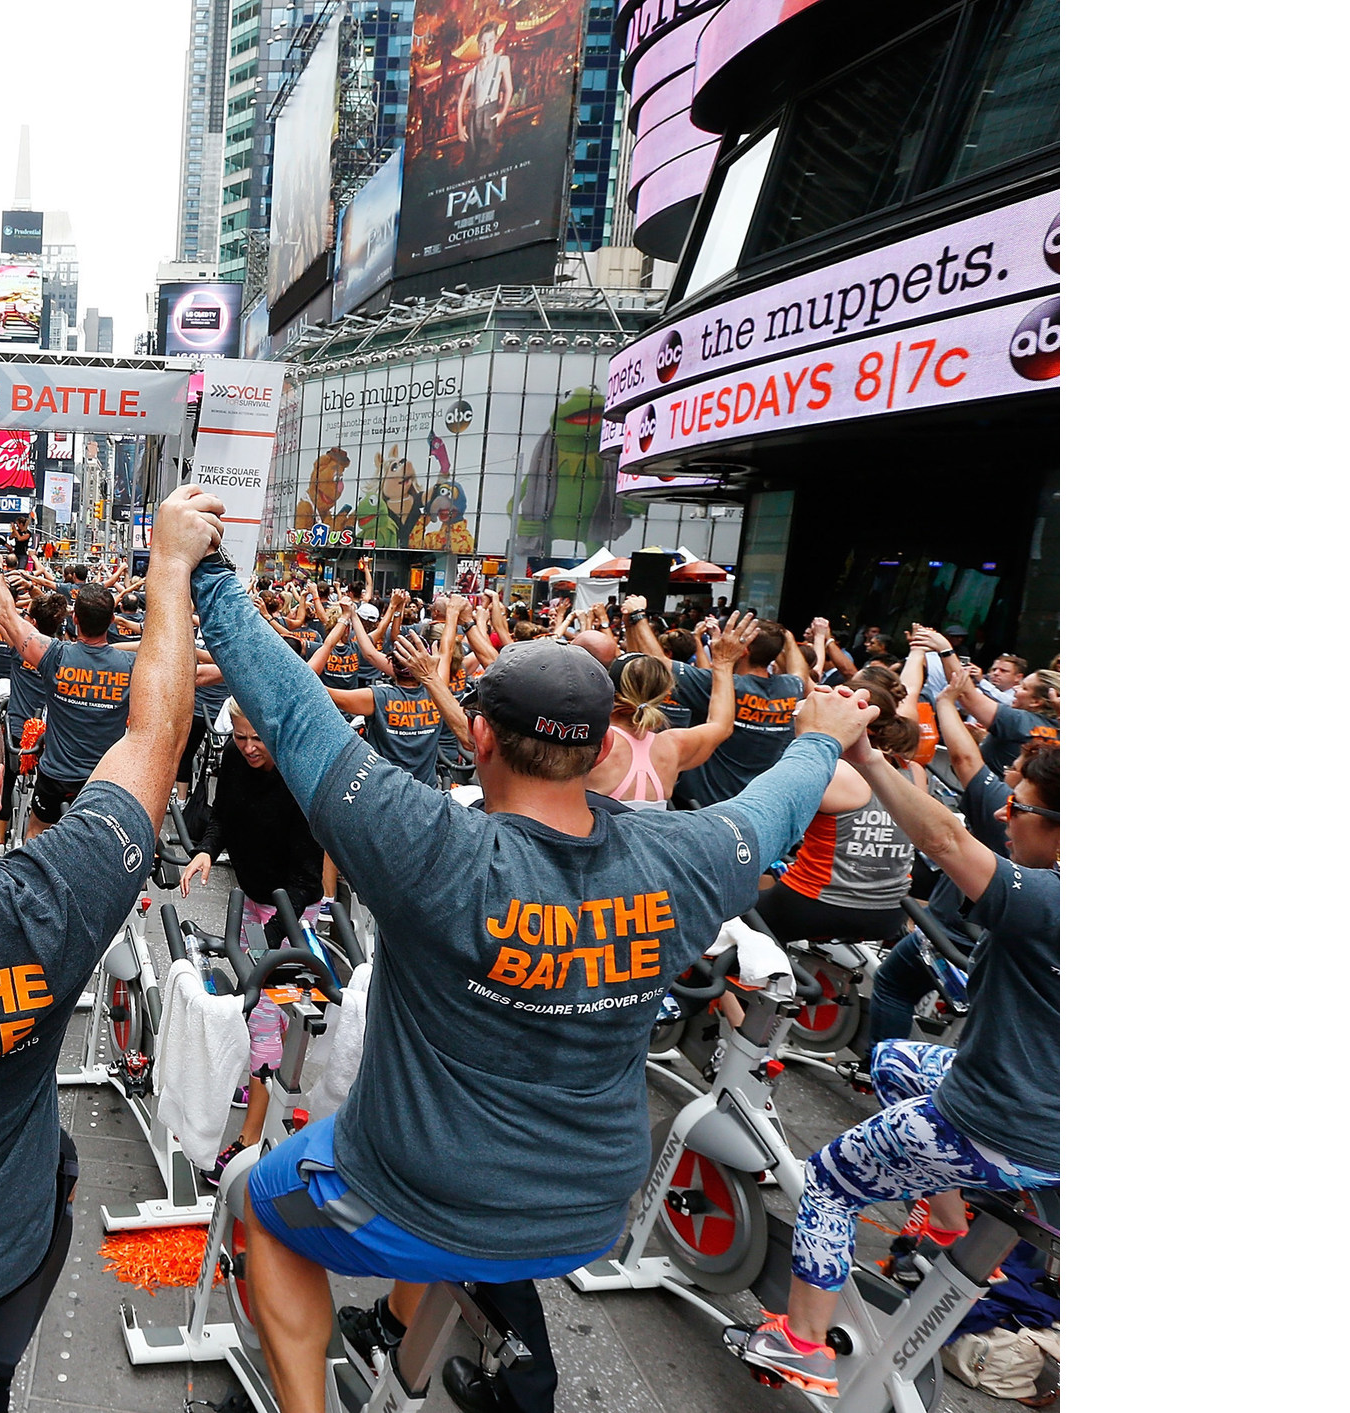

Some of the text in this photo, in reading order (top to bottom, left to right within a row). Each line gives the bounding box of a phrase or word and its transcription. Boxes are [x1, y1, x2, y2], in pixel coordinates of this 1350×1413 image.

[446, 176, 508, 218] PAN
[448, 225, 492, 243] OCTOBER
[493, 221, 499, 231] 9
[656, 341, 683, 371] abc
[701, 317, 755, 361] the
[763, 240, 1009, 343] muppets.
[11, 384, 146, 418] BATTLE.
[227, 385, 273, 401] CYCLE
[323, 374, 462, 411] the muppets.
[639, 415, 657, 438] abc
[670, 362, 834, 440] TUESDAYS
[239, 400, 270, 408] SURVIVAL
[340, 417, 371, 428] another
[372, 414, 385, 426] day
[389, 412, 398, 423] in
[399, 408, 443, 423] hollywood
[446, 408, 473, 424] abc
[371, 426, 400, 436] tuesday
[419, 422, 430, 431] 22
[197, 473, 261, 488] TAKEOVER
[200, 465, 260, 477] TIMES SQUARE
[55, 666, 131, 687] JOIN THE
[57, 681, 123, 701] BATTLE
[385, 700, 437, 713] JOIN TH
[737, 706, 794, 724] BATTLE
[388, 713, 440, 727] BATTLE
[535, 716, 590, 740] NYR
[851, 825, 894, 842] THE
[486, 891, 676, 947] JOIN THE
[487, 938, 662, 991] BATTLE
[467, 979, 665, 1016] TIMES SQUARE TAKEOVER 2015
[637, 1131, 682, 1226] SCHWINN
[892, 1285, 962, 1370] SCHWINN
